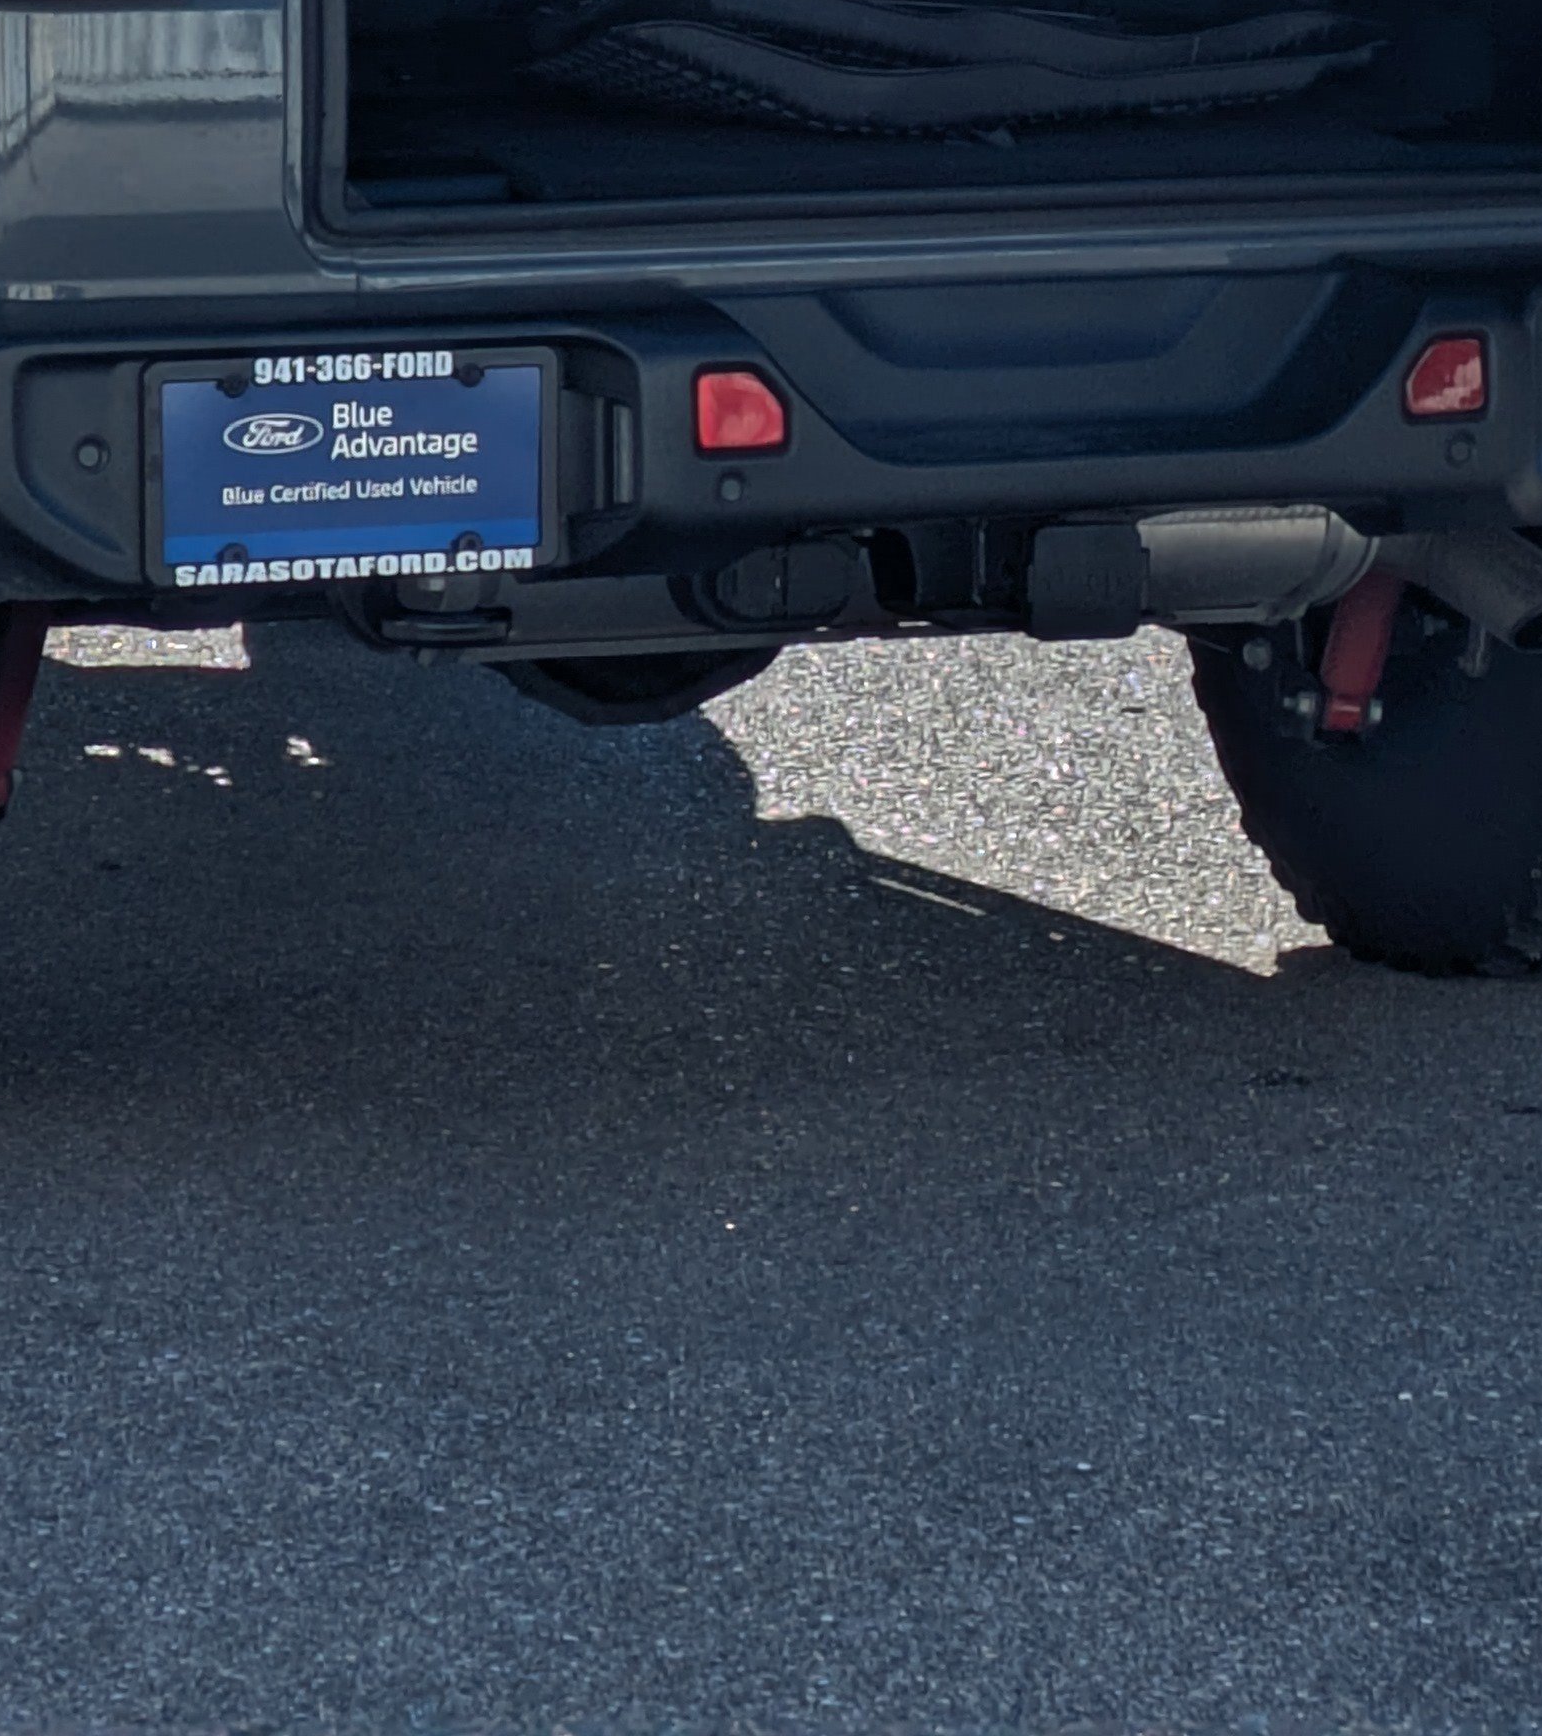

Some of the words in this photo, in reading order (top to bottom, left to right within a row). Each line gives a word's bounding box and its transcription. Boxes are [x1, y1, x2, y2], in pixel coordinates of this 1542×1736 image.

[254, 351, 453, 385] 941-366-FORD
[332, 401, 393, 430] Blue
[242, 419, 305, 448] Ford
[331, 431, 478, 460] Advantage
[222, 486, 265, 506] Blue
[270, 481, 350, 503] Certified
[356, 478, 404, 499] Used
[410, 474, 478, 496] Vehicle
[174, 547, 534, 587] SARASOTAFORD.COM
